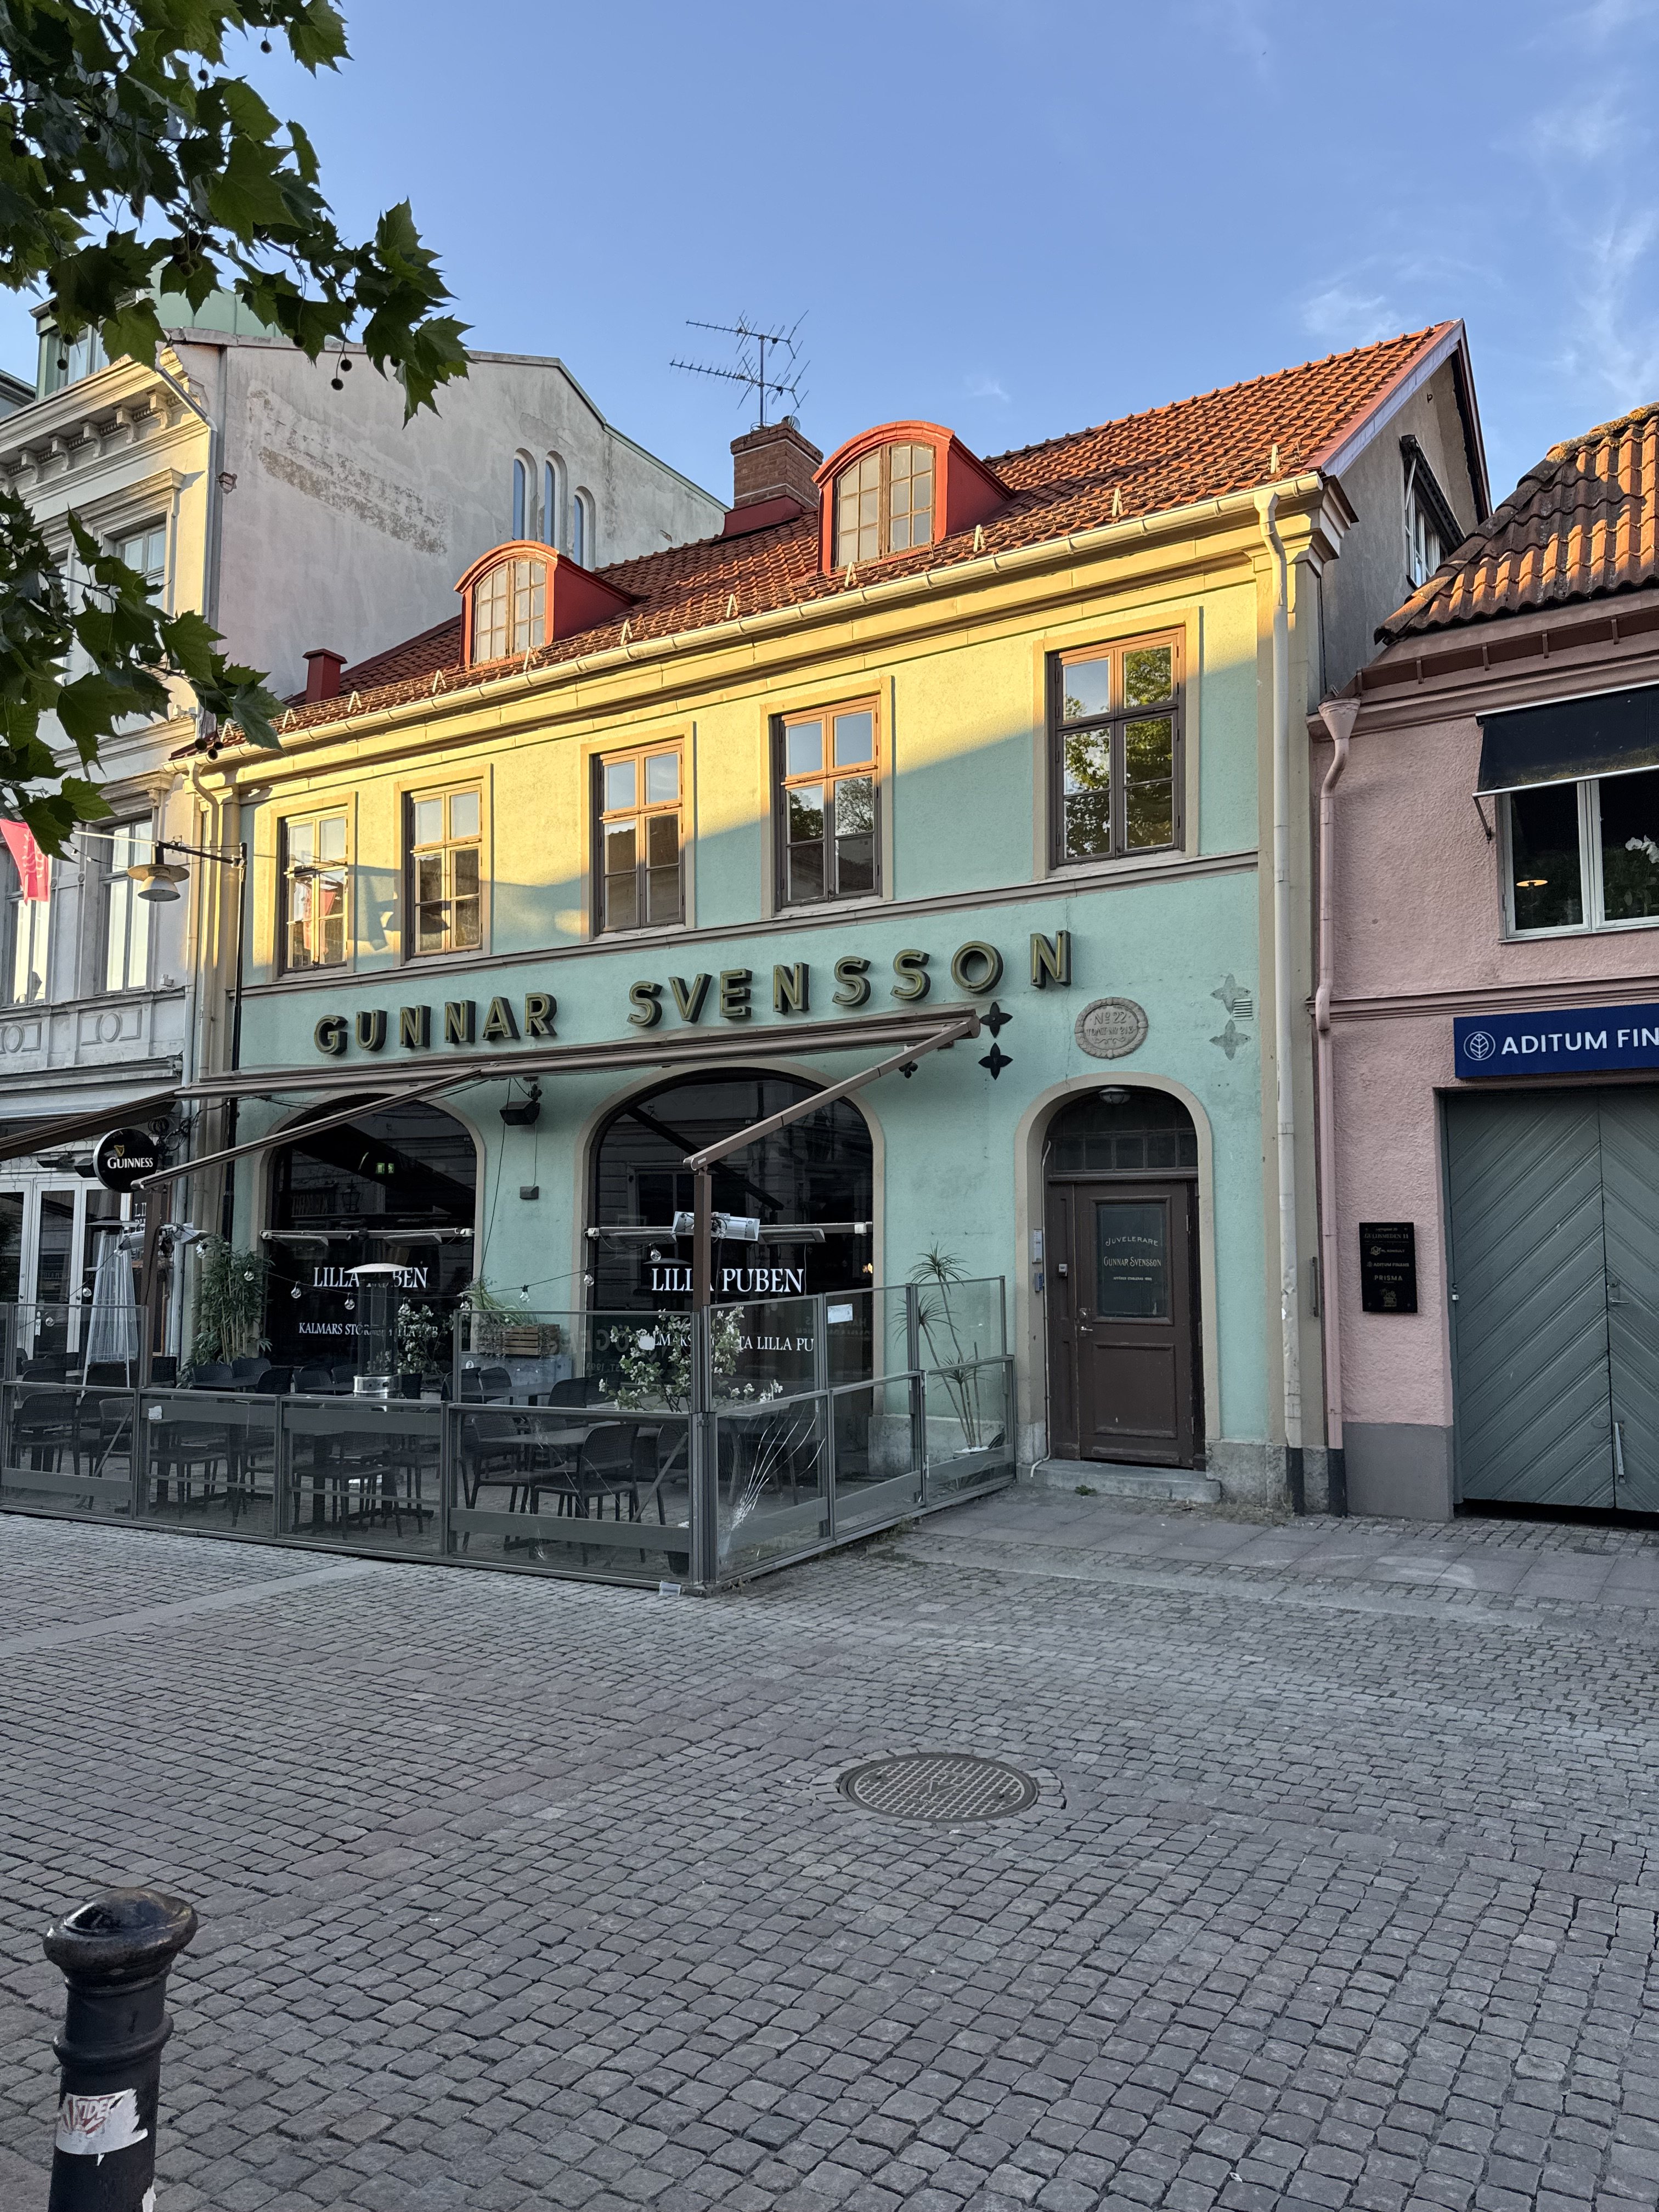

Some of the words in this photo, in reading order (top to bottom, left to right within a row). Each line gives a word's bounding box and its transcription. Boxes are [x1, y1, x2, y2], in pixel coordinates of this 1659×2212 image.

[314, 992, 557, 1056] GUNNAR
[627, 930, 1071, 1027] SVENSSON
[1113, 1011, 1127, 1024] 22
[1501, 1030, 1607, 1055] ADITUM
[107, 1157, 154, 1169] GUINNESS
[1105, 1236, 1159, 1246] JUVELERARE
[1103, 1256, 1128, 1267] GUNNAR
[1130, 1256, 1161, 1267] SVENSSON
[313, 1267, 360, 1288] LILLA
[651, 1268, 714, 1291] LILL
[721, 1268, 804, 1293] PUBEN
[298, 1322, 343, 1335] KALMARS
[757, 1336, 793, 1351] LILLA
[796, 1338, 815, 1352] PU
